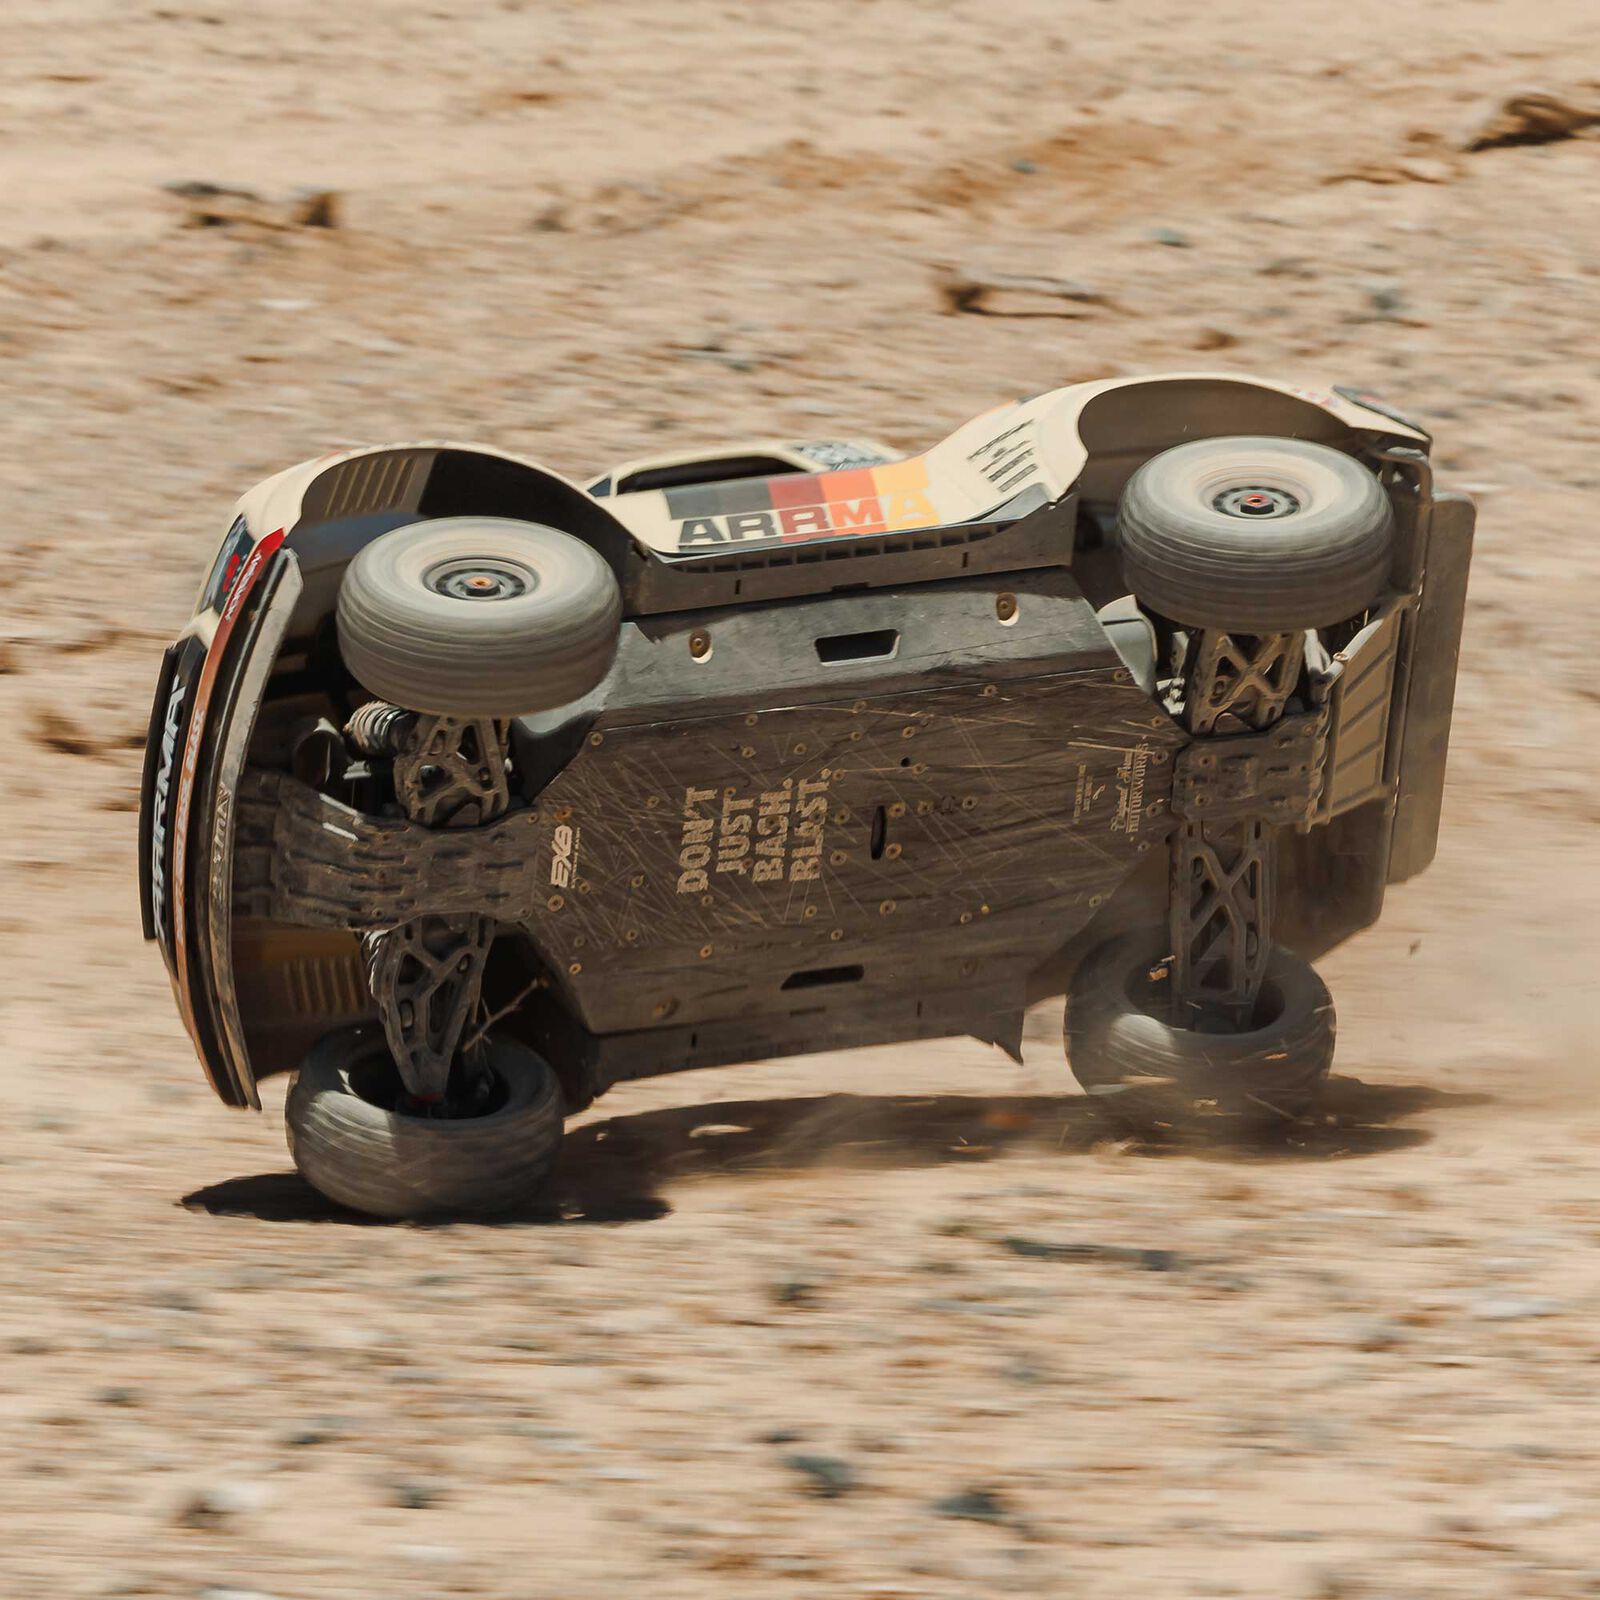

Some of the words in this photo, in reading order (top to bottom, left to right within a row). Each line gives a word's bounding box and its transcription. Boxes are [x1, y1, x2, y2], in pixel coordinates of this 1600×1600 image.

[679, 495, 938, 544] ARRMA
[152, 674, 187, 942] ARRMA
[677, 786, 718, 894] DON'T
[716, 797, 754, 875] JUST
[752, 777, 793, 883] BASH.
[789, 767, 832, 882] BLAST.
[1128, 743, 1149, 833] MOTORWORKS
